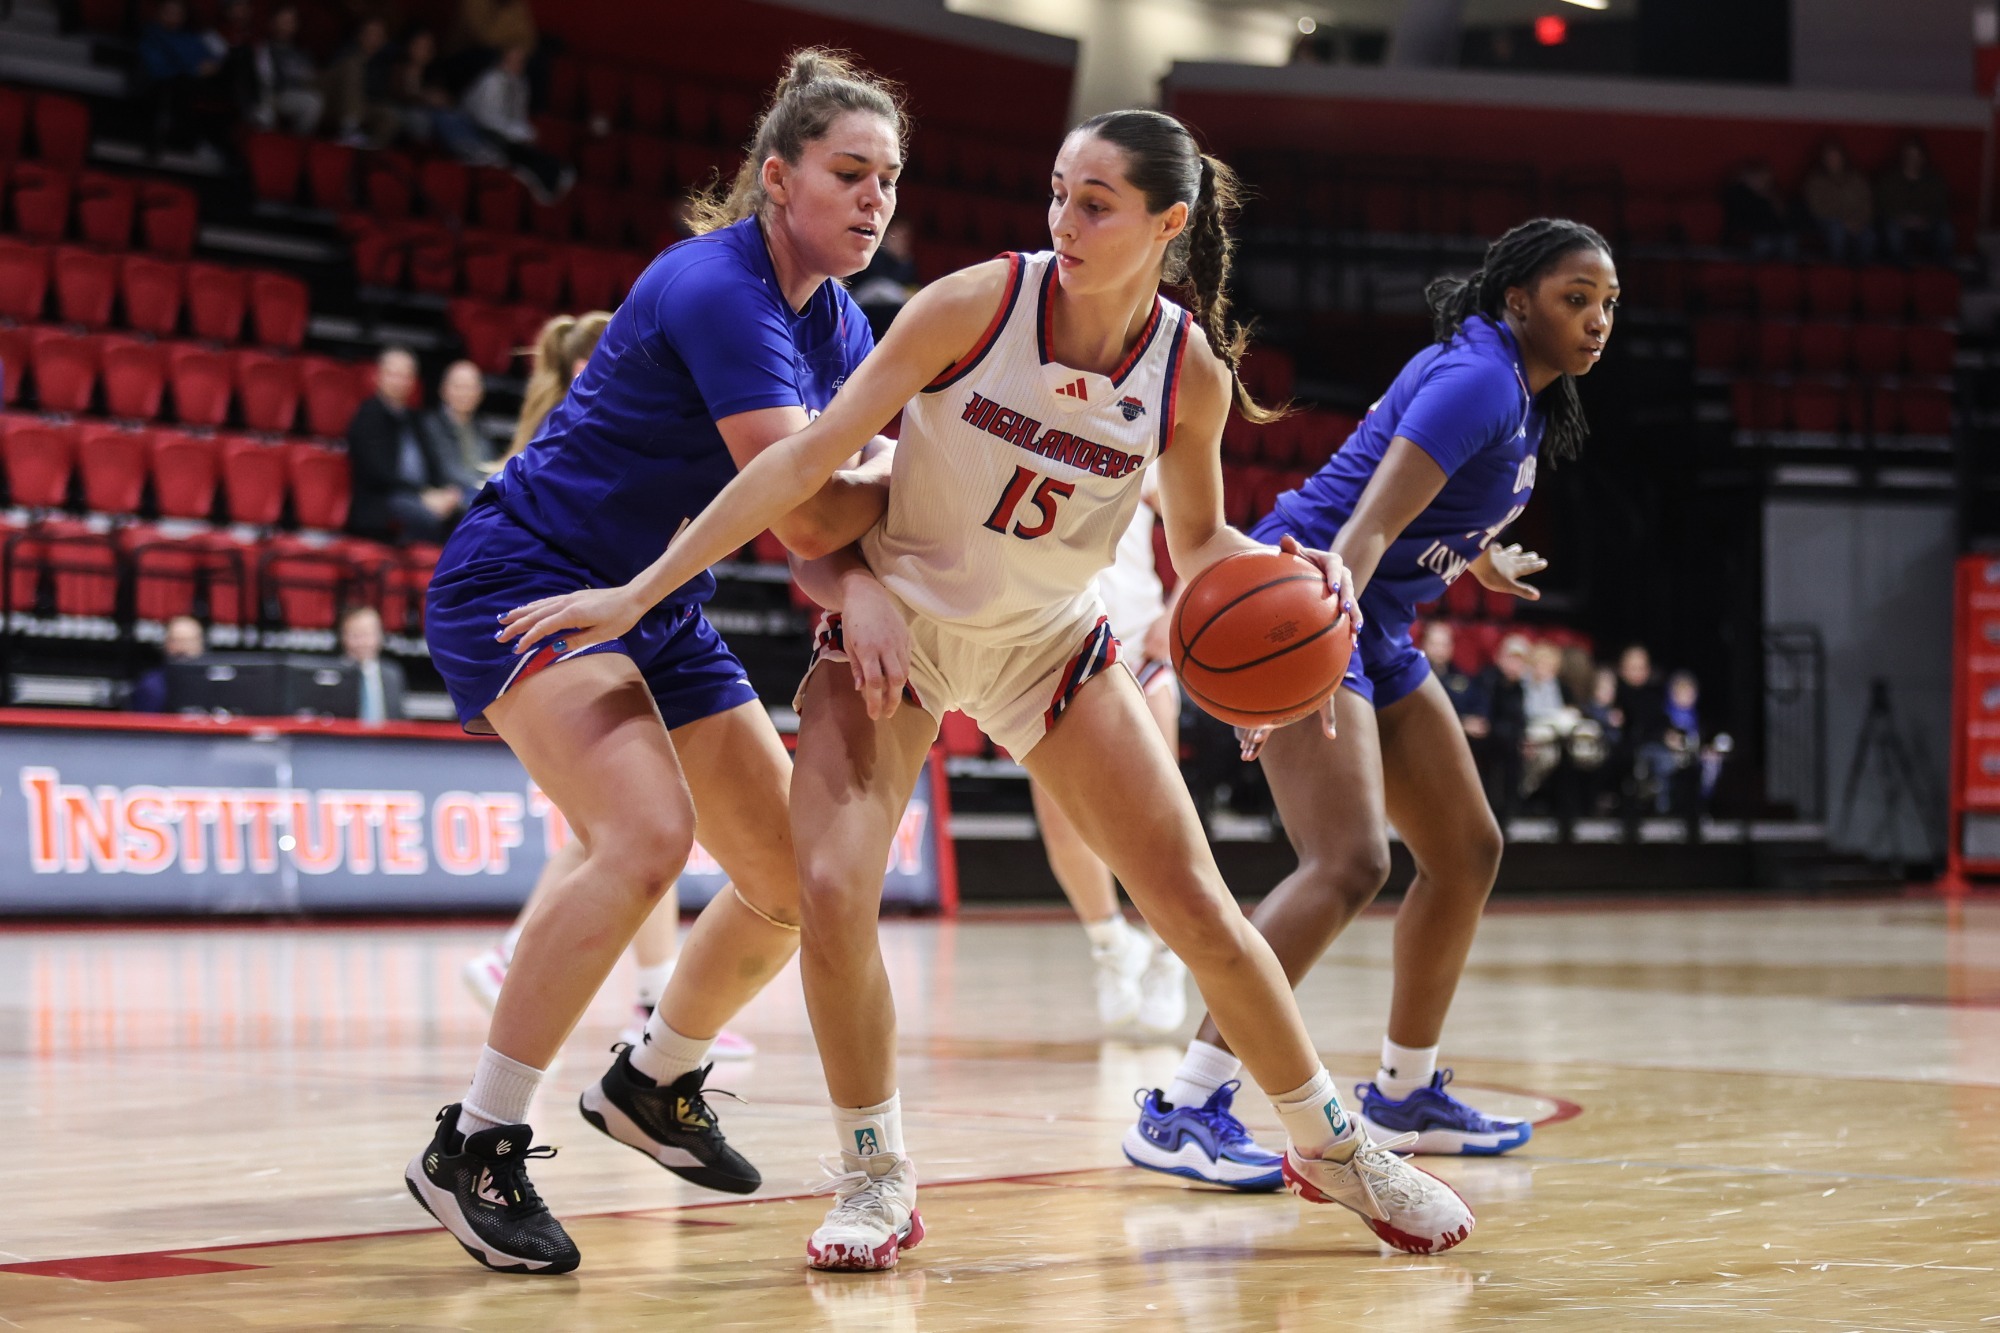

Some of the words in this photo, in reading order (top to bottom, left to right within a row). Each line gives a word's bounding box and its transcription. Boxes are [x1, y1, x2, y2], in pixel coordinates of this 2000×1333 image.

[961, 391, 1145, 479] HIGHLANDERS
[982, 464, 1076, 540] 15
[19, 766, 428, 875] INSTITUTE
[431, 790, 525, 875] OF
